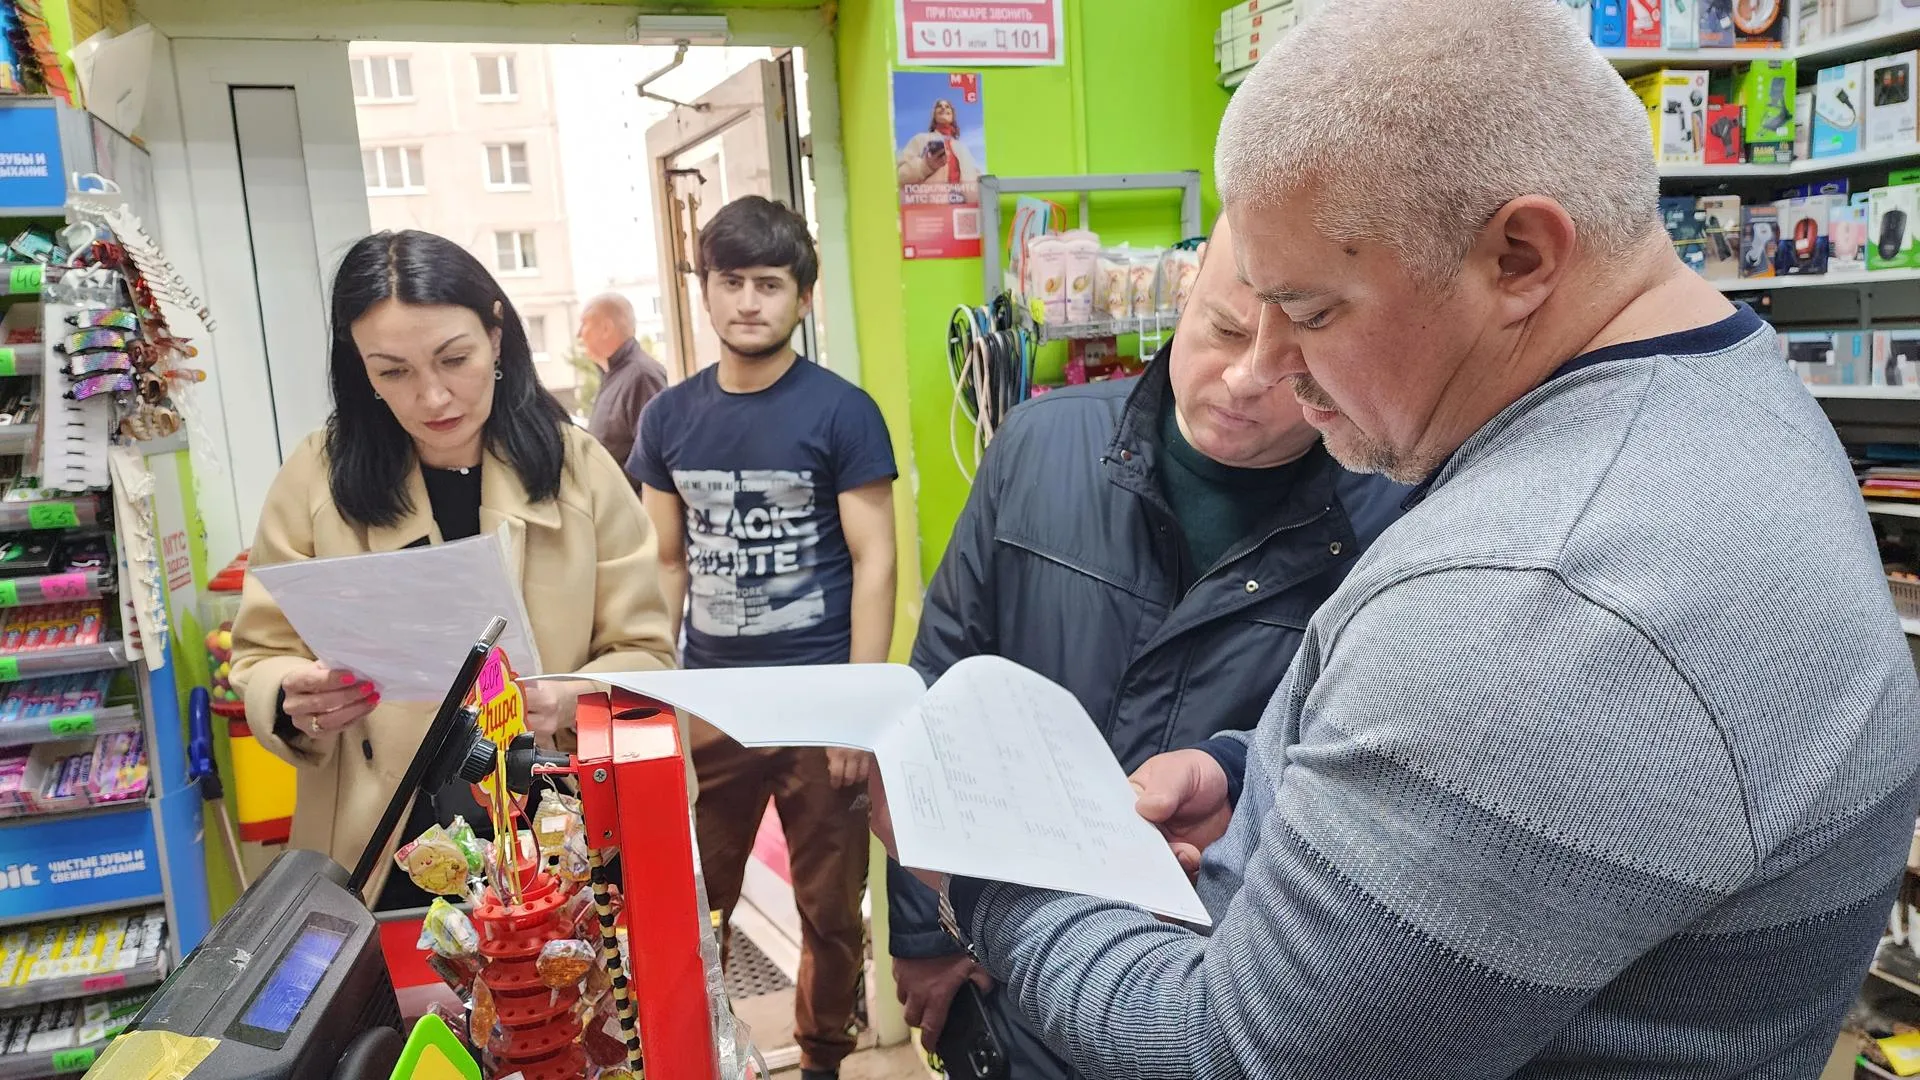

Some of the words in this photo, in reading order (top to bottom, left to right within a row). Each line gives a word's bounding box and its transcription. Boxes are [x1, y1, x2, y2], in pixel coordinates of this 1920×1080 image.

[925, 7, 946, 20] ПРИ
[947, 7, 987, 20] ПОЖАРЕ
[990, 8, 1033, 21] ЗВОНИТЬ
[942, 28, 962, 48] 01
[968, 40, 987, 48] или
[1011, 29, 1040, 49] 101
[36, 152, 47, 165] И
[904, 194, 929, 205] МТС
[163, 532, 187, 556] МТС
[48, 855, 98, 873] ЧИСТЫЕ
[99, 851, 133, 867] ЗУБЫ
[134, 849, 144, 861] И
[51, 868, 92, 884] СВЕЖЕЕ
[93, 860, 146, 878] ДЫХАНИЕ
